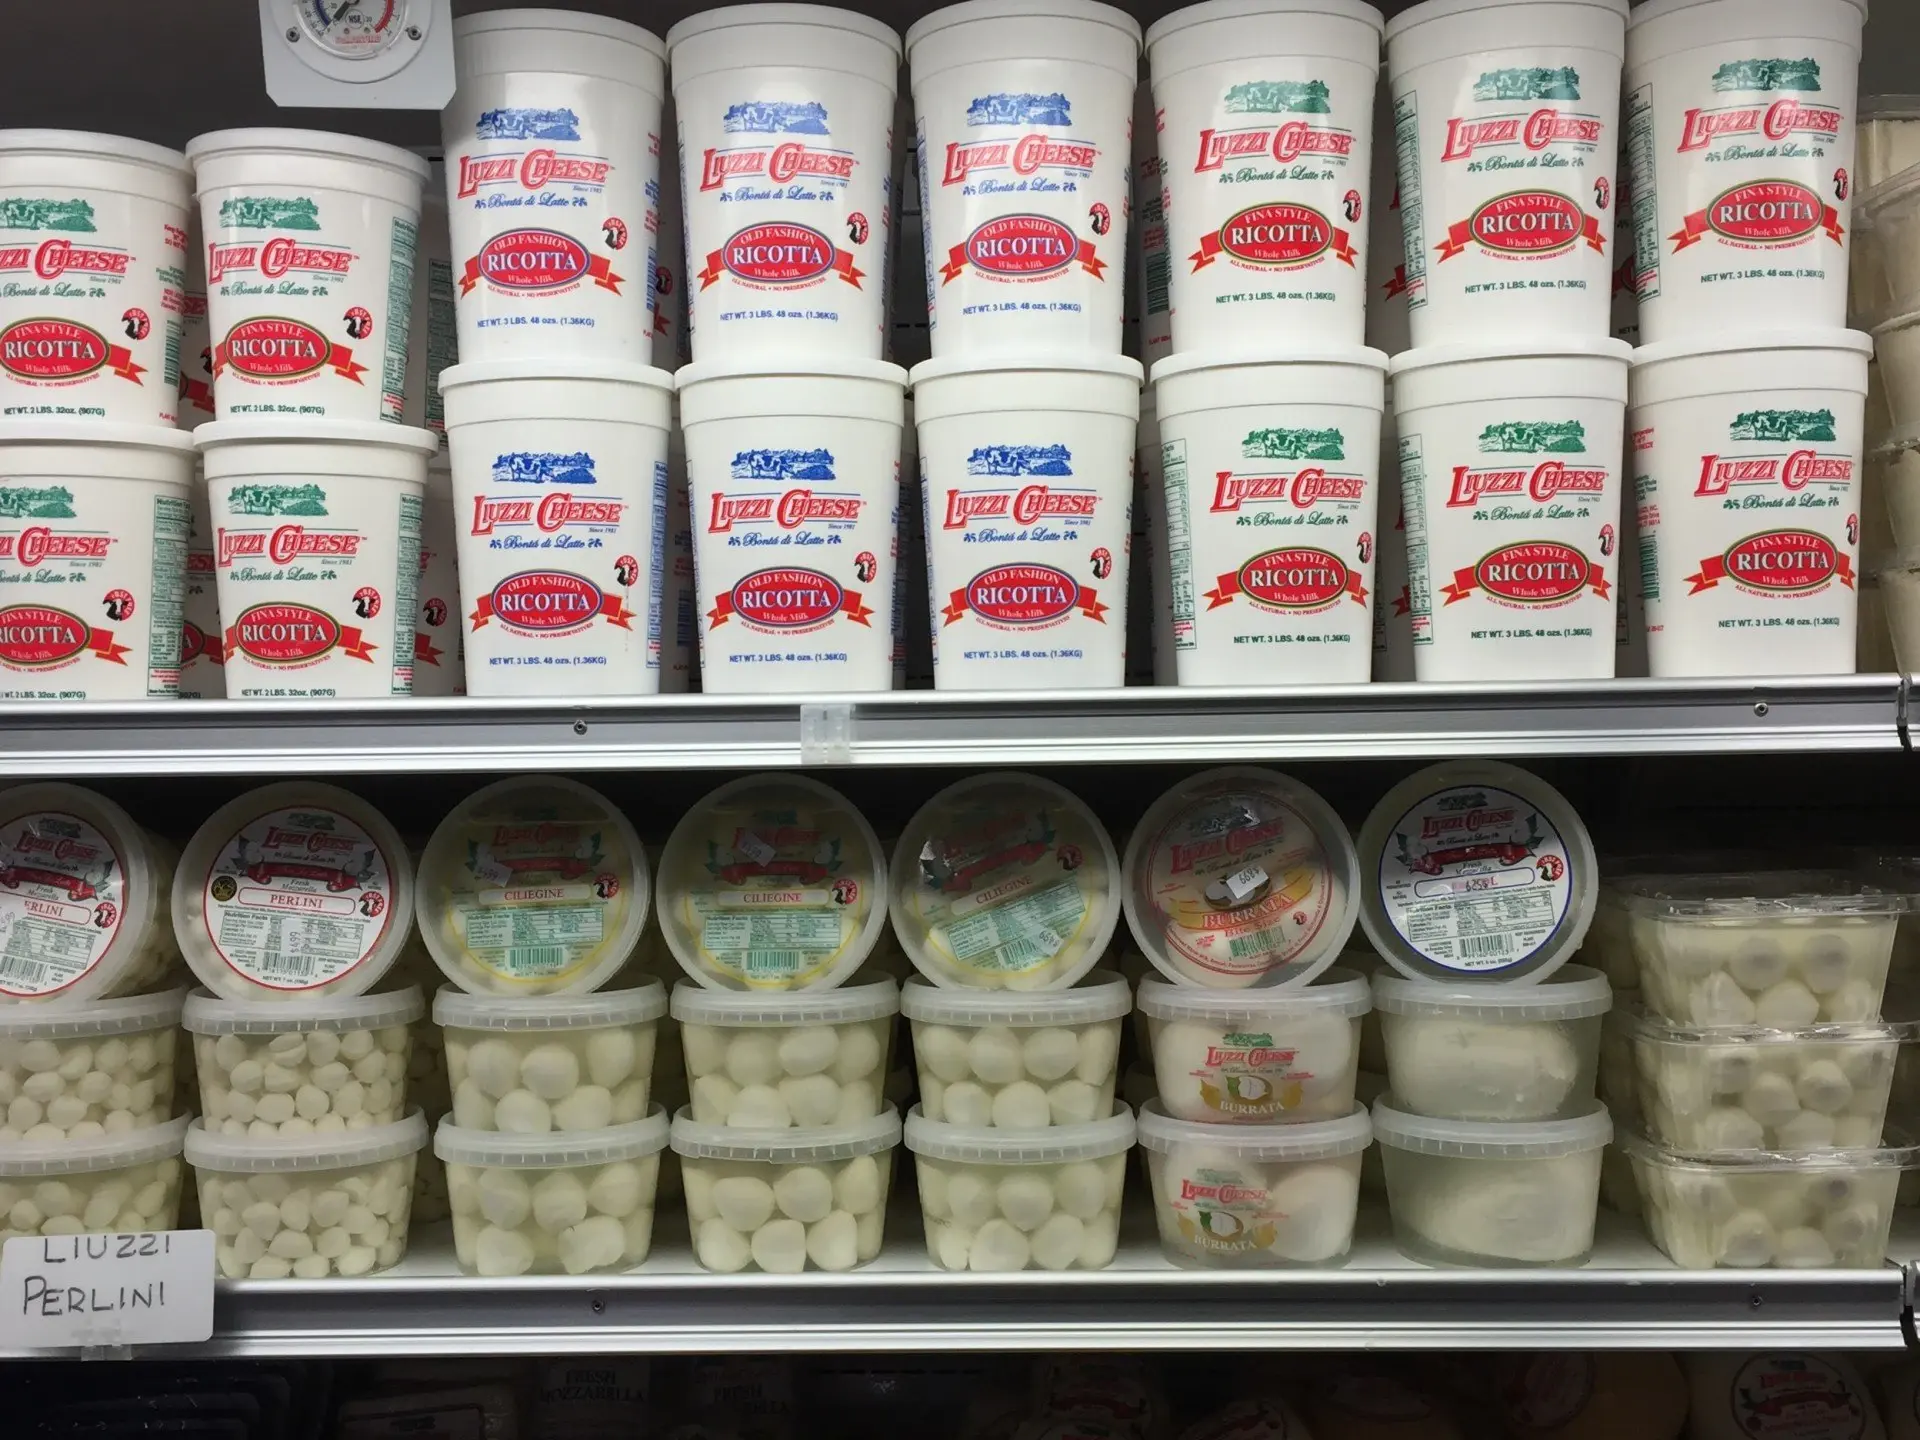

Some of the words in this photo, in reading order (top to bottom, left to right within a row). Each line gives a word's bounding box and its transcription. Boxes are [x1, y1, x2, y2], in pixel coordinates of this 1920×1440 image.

[1764, 100, 1841, 140] CHEESE
[1523, 109, 1600, 150] CHEESE
[1273, 122, 1351, 163] CHEESE
[769, 143, 854, 183] CHEESE
[1013, 134, 1097, 175] CHEESE
[520, 149, 609, 190] CHEESE
[1720, 202, 1813, 223] RICOTTA
[984, 222, 1007, 237] OLD
[1010, 220, 1058, 236] FASHION
[1482, 213, 1574, 234] RICOTTA
[494, 237, 516, 251] OLD
[518, 235, 568, 250] FASHION
[741, 230, 763, 245] OLD
[766, 228, 816, 245] FASHION
[1232, 225, 1322, 245] RICOTTA
[733, 246, 823, 265] RICOTTA
[976, 238, 1066, 258] RICOTTA
[261, 237, 352, 279] CHEESE
[488, 252, 577, 272] RICOTTA
[4, 341, 96, 359] RICOTTA
[232, 339, 317, 358] RICOTTA
[1782, 450, 1852, 491] CHEESE
[1291, 469, 1364, 508] CHEESE
[1529, 462, 1605, 502] CHEESE
[537, 492, 623, 533] CHEESE
[777, 489, 862, 529] CHEESE
[1013, 485, 1098, 525] CHEESE
[1294, 514, 1304, 525] di
[541, 537, 551, 548] di
[781, 534, 791, 545] di
[1017, 530, 1027, 541] di
[270, 525, 361, 565] CHEESE
[1737, 552, 1829, 570] RICOTTA
[749, 575, 772, 589] OLD
[775, 573, 824, 588] FASHION
[984, 572, 1007, 586] OLD
[1010, 570, 1060, 585] FASHION
[1251, 569, 1339, 587] RICOTTA
[1488, 563, 1580, 581] RICOTTA
[508, 577, 530, 592] OLD
[533, 576, 583, 591] FASHION
[501, 593, 590, 611] RICOTTA
[742, 590, 831, 608] RICOTTA
[977, 587, 1067, 605] RICOTTA
[1719, 619, 1735, 627] NET
[242, 624, 327, 642] RICOTTA
[1234, 636, 1248, 644] NET
[1268, 635, 1272, 643] 3
[964, 651, 978, 659] NET
[271, 894, 323, 909] PERLINI
[504, 888, 564, 901] CILIEGINE
[743, 893, 802, 903] CILIEGINE
[24, 900, 64, 918] ERLINI
[1203, 892, 1293, 928] BURRATA
[1220, 1100, 1285, 1115] BURRATA
[44, 1233, 170, 1263] LIUZZI
[1194, 1234, 1256, 1251] BURRATA
[23, 1275, 165, 1317] PERLINI
